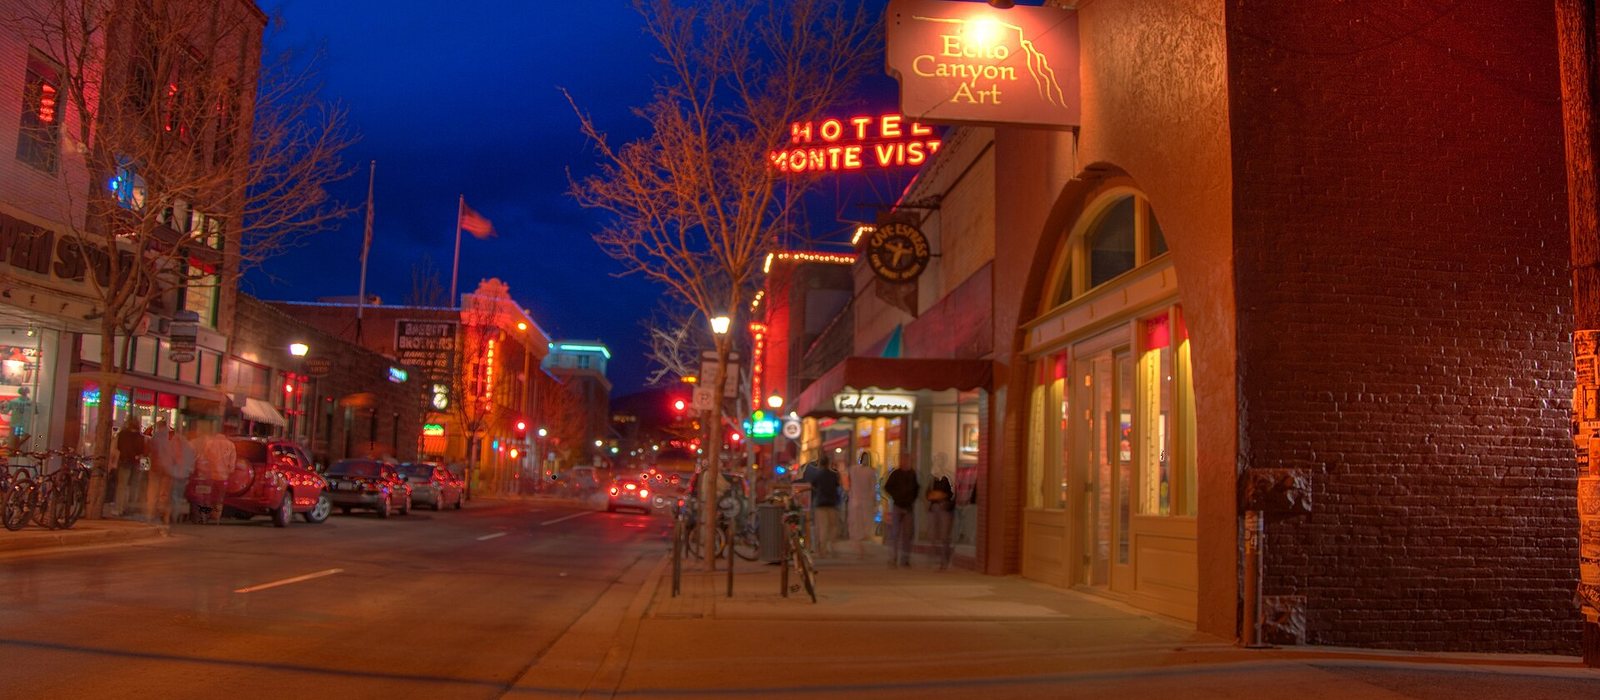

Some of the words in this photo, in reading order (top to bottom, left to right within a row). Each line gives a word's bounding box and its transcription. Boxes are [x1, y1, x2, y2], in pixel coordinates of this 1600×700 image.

[912, 54, 1018, 88] Canyon
[950, 81, 1002, 105] Art
[791, 114, 933, 144] HOTEL
[768, 144, 863, 173] MONTE
